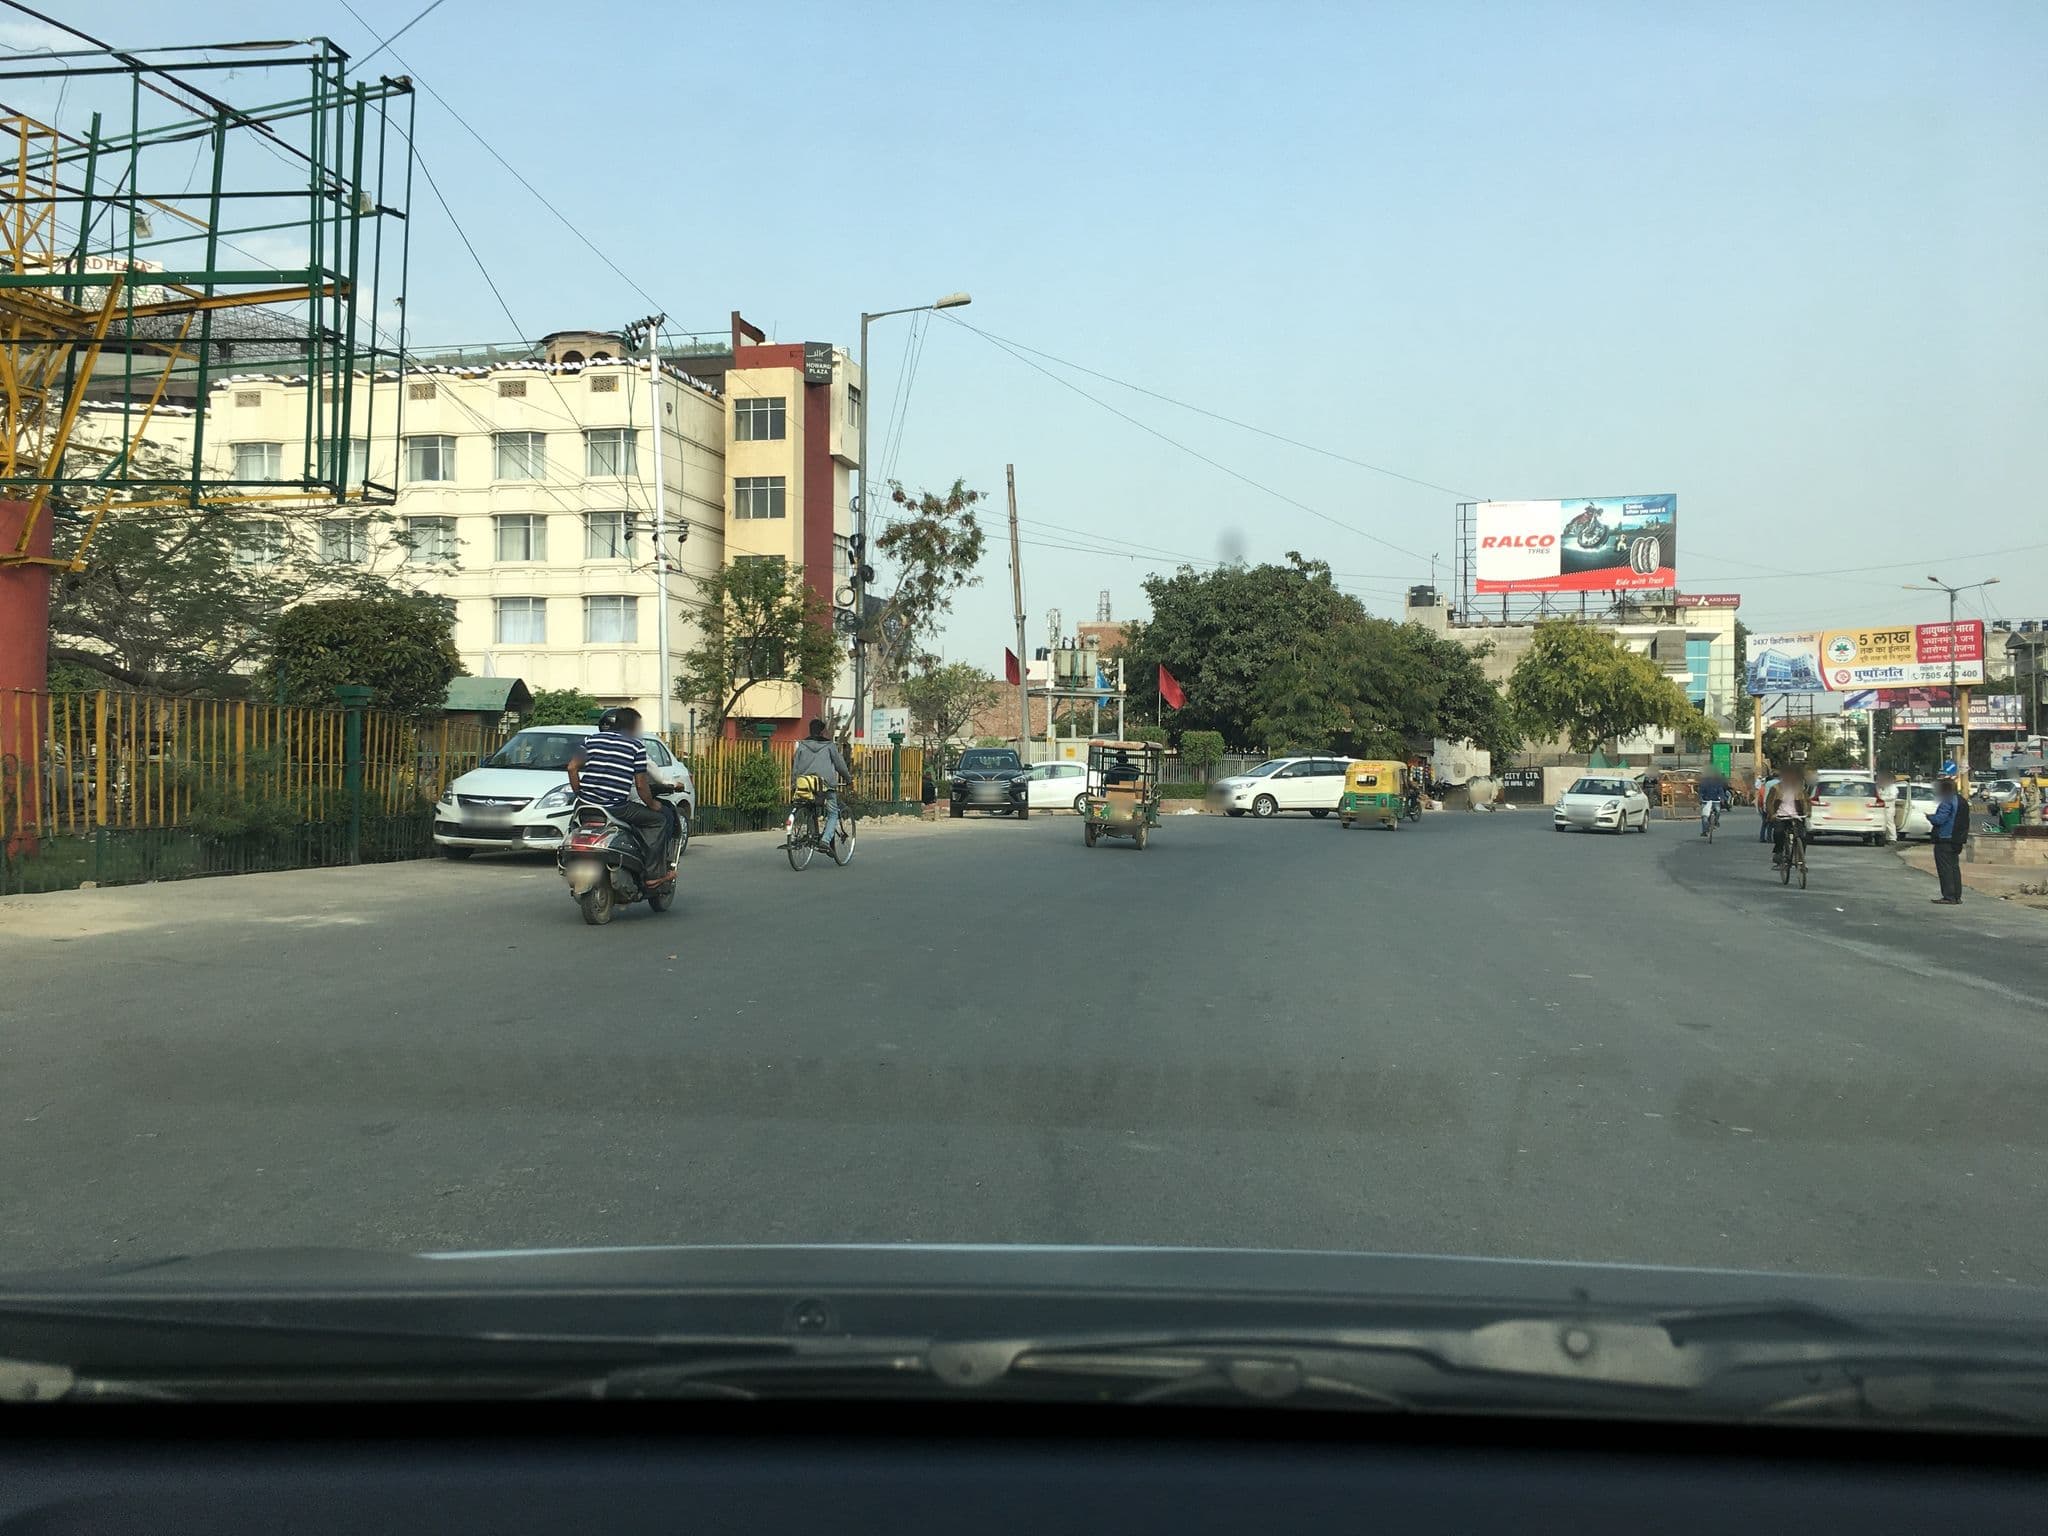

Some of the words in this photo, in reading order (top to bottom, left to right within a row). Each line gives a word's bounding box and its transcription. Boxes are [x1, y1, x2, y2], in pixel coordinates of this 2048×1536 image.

[1481, 534, 1556, 549] RALCO
[1615, 578, 1630, 586] Ride
[1631, 577, 1646, 585] with
[1955, 623, 1976, 633] भारत
[1859, 633, 1868, 646] 5
[1872, 630, 1912, 645] लाख
[1960, 635, 1974, 643] जन
[1859, 647, 1873, 655] तक
[1920, 671, 1941, 680] 7505
[1943, 670, 1959, 679] 400
[1962, 669, 1978, 678] 400
[1504, 771, 1521, 780] CITY
